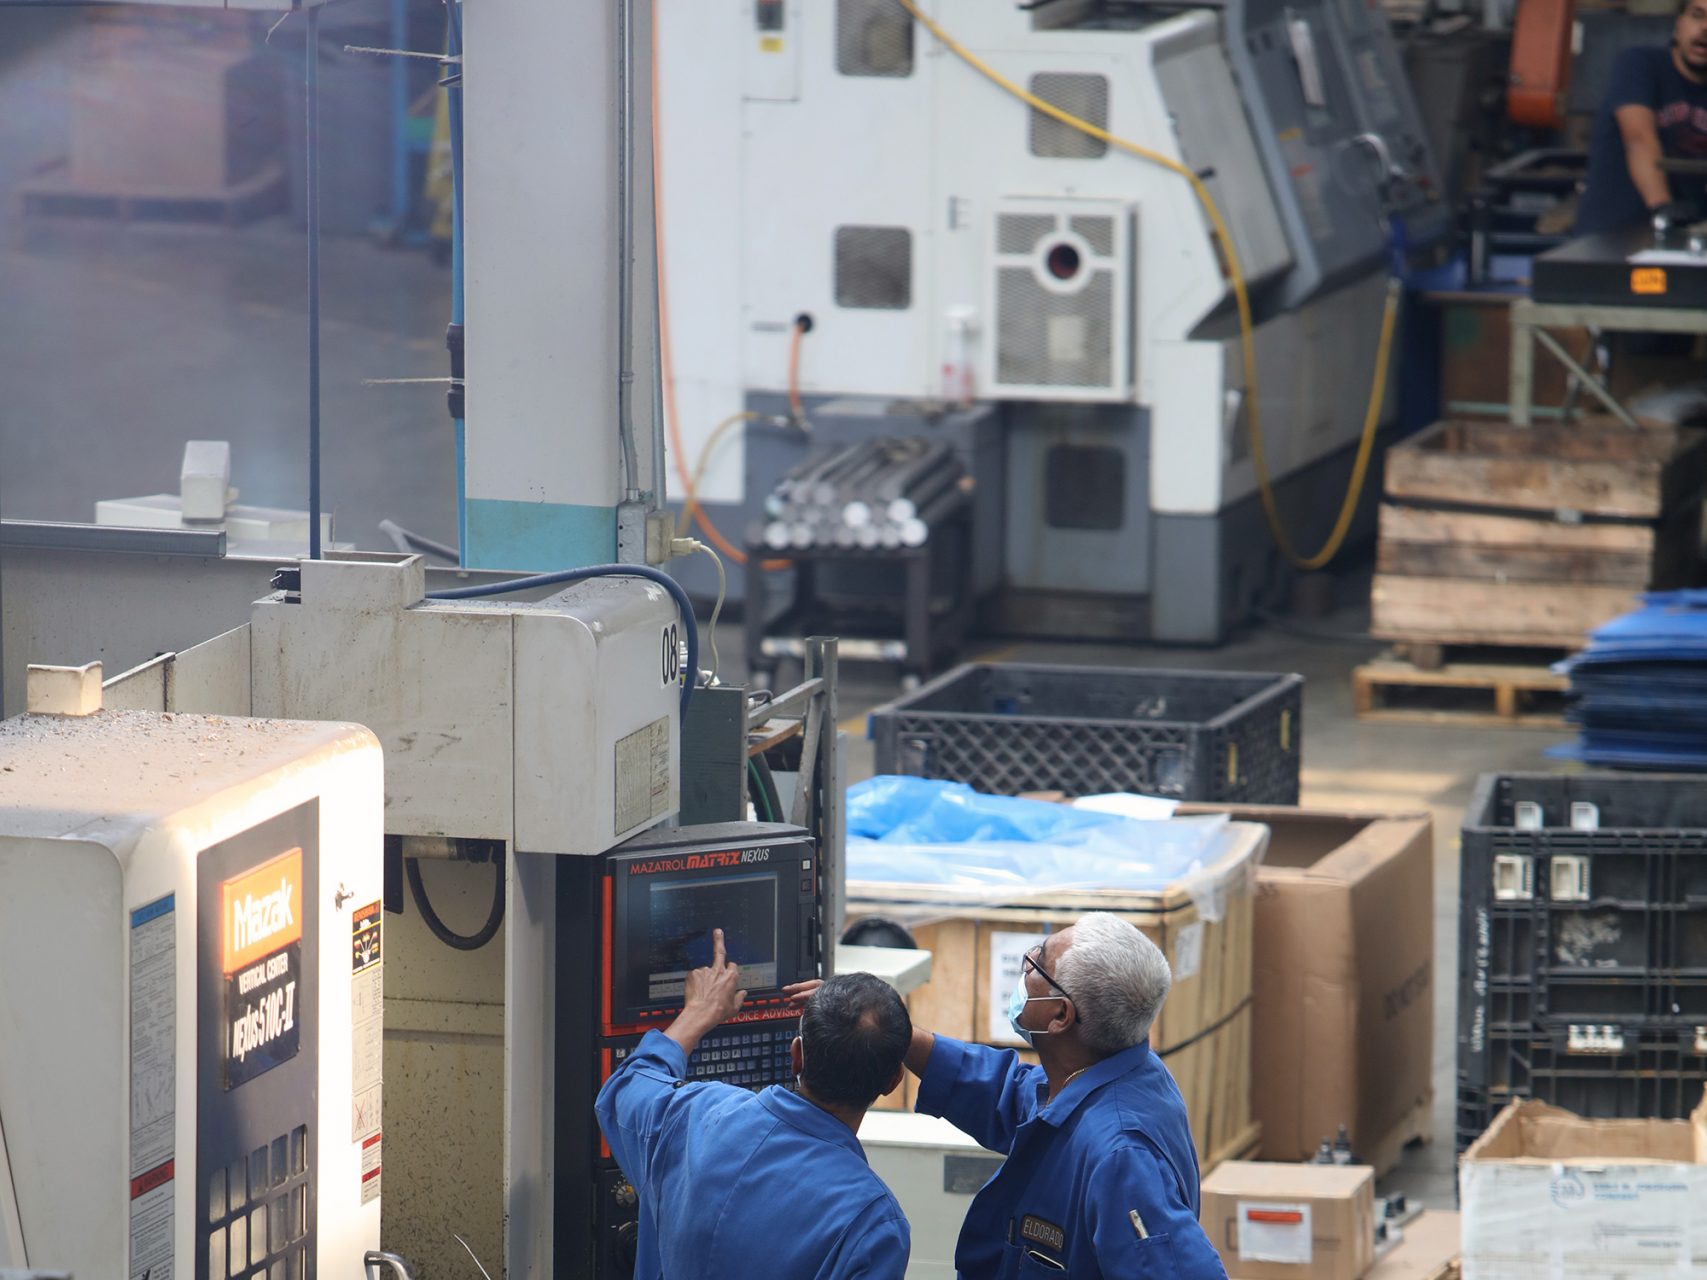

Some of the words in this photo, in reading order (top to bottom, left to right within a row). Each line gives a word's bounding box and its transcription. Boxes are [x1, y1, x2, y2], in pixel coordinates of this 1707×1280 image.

[662, 624, 678, 685] 08
[630, 859, 686, 875] MAZATROL
[741, 848, 770, 863] NEXUS
[233, 877, 294, 951] Mazak
[239, 963, 267, 995] VERTICAL
[267, 952, 288, 980] CENTER
[1023, 1219, 1064, 1248] ELDORADO
